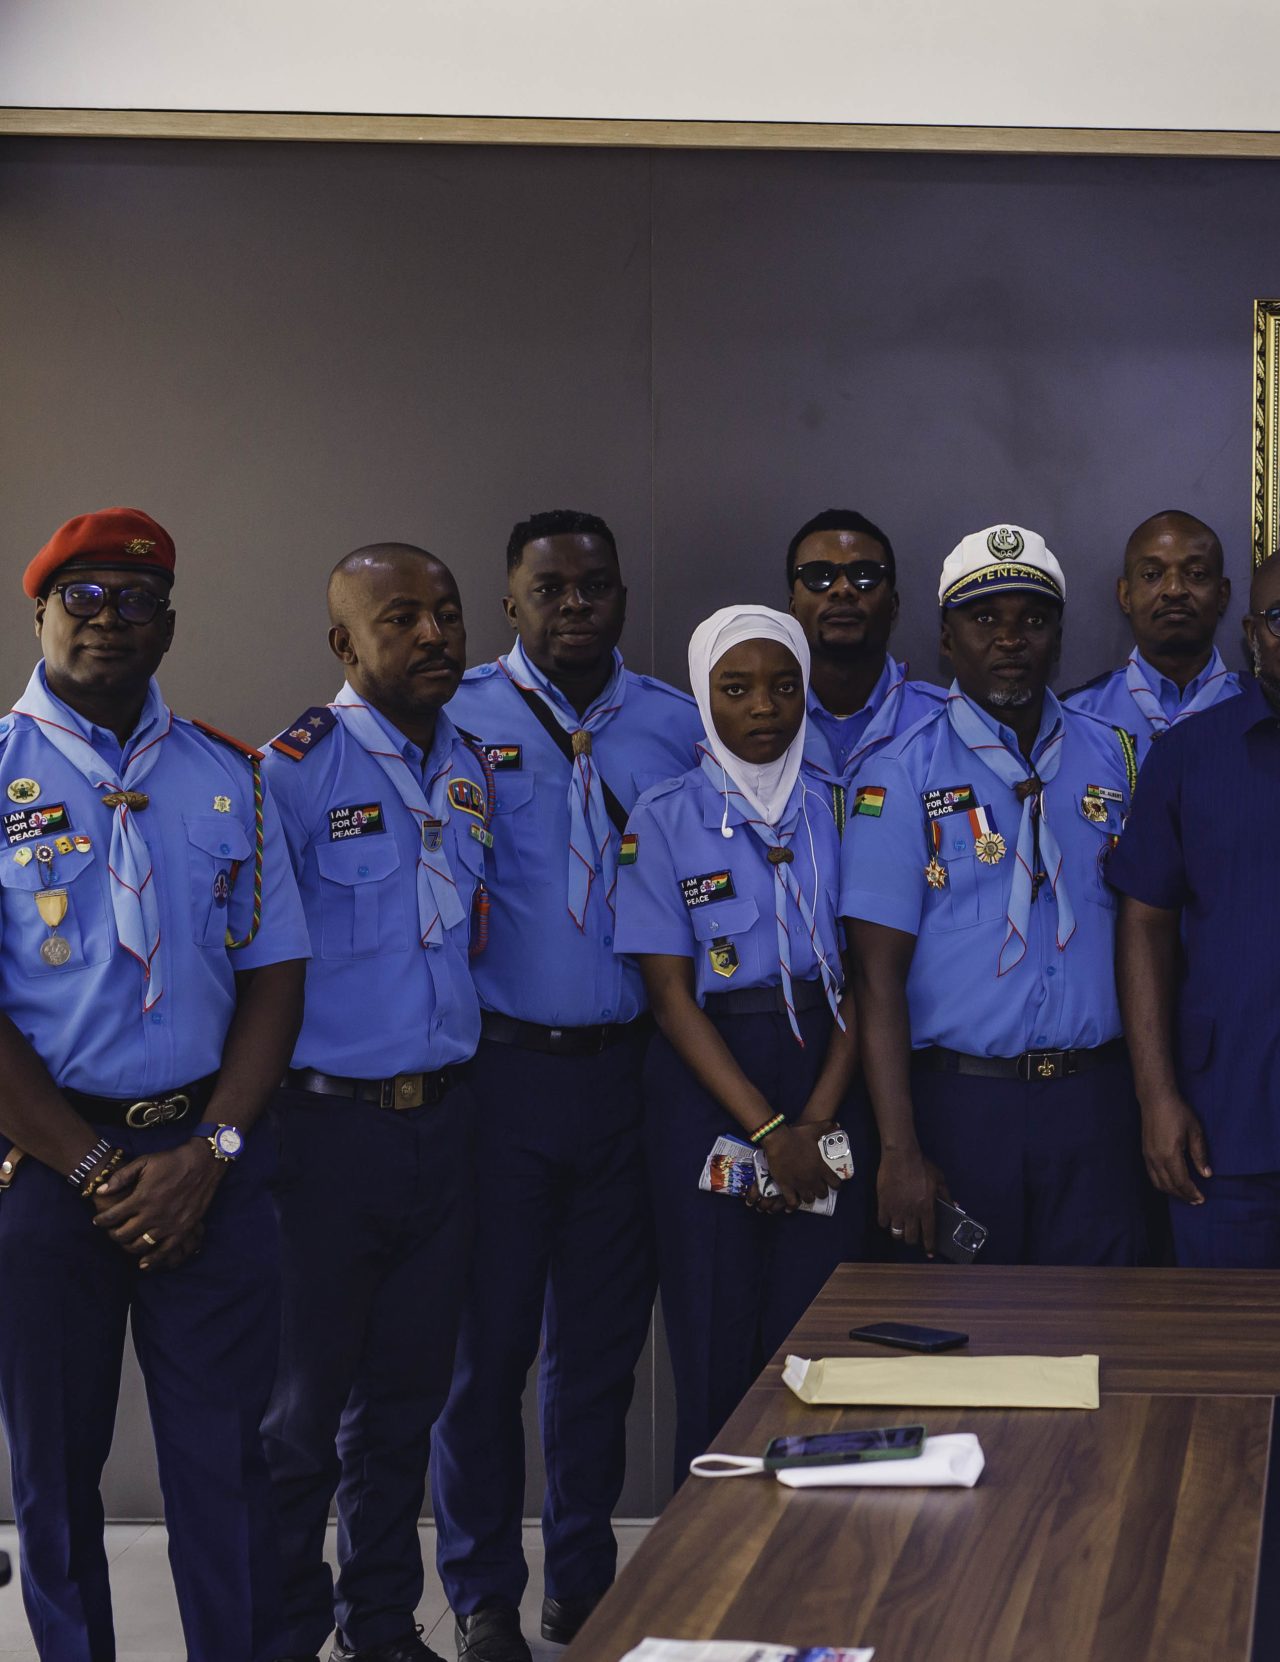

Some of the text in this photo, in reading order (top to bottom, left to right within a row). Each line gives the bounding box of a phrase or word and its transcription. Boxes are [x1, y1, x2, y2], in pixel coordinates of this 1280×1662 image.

[929, 790, 940, 799] AM
[926, 799, 942, 810] FOR
[331, 808, 349, 819] I AM
[928, 805, 953, 818] PEACE
[4, 811, 25, 824] I AM
[6, 822, 28, 834] FOR
[331, 819, 350, 830] FOR
[9, 828, 43, 844] PEACE
[332, 827, 361, 839] PEACE
[686, 878, 697, 887] AM
[684, 888, 699, 897] FOR
[686, 894, 709, 906] PEACE
